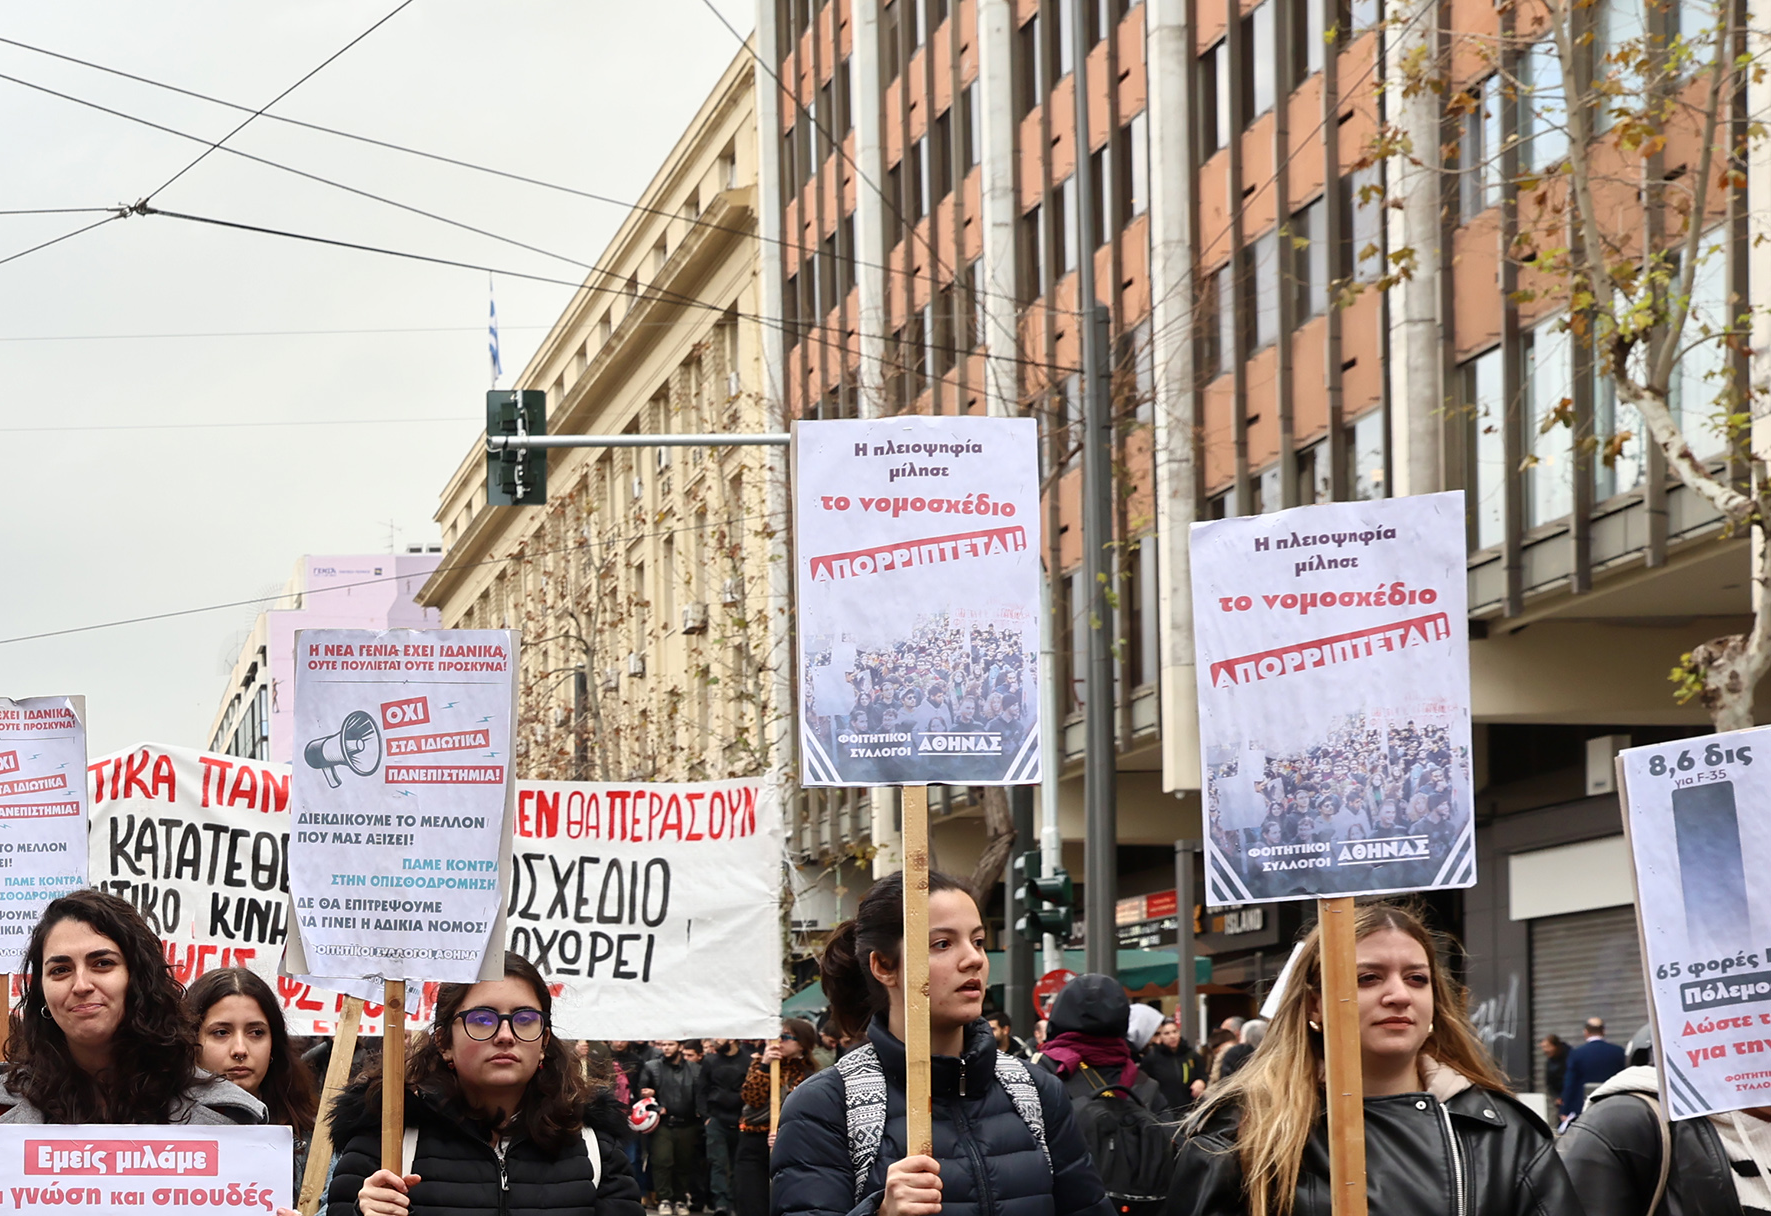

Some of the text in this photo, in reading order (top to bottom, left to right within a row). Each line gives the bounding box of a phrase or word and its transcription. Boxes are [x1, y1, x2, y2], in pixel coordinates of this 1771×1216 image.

[855, 439, 982, 457] Η πλειοψηφία
[889, 463, 949, 482] μίλησε
[821, 493, 1016, 518] το νομοσχέδιο
[1255, 525, 1396, 551] Η πλειοψηφία
[813, 531, 1025, 581] ΑΠΟΡΡΙΠΤΕΤΑΙ!
[1295, 555, 1358, 576] μίλησε
[1219, 582, 1437, 615] το νομοσχέδιο
[310, 644, 507, 660] Η ΝΕΑ ΓΕΝΙΑ ΕΧΕΙ ΙΔΑΝΙΚΑ,
[1214, 618, 1448, 688] ΑΠΟΡΡΙΠΤΕΤΑΙ!
[386, 702, 424, 724] ΟΧΙ
[390, 733, 486, 752] ΣΤΑ ΙΔΙΩΤΙΚΑ
[838, 732, 911, 744] ΦΟΙΤΗΤΙΚΟΙ
[919, 736, 1002, 751] ΑΘΗΝΑΣ
[850, 747, 911, 758] ΣΥΛΛΟΓΟΙ
[1649, 743, 1753, 779] 8,6 δις
[199, 757, 292, 814] ΠΑΝ
[388, 769, 499, 781] ΠΑΝΕΠΙΣΤΗΜΙΑ!
[1675, 769, 1727, 789] για F-35
[514, 786, 758, 842] ΕΝ ΘΑ ΠΕΡΑΣΟΥΝ
[1248, 842, 1330, 857] ΦΟΙΤΗΤΙΚΟΙ
[1338, 839, 1430, 862] ΑΘΗΝΑΣ
[1263, 857, 1331, 872] ΣΥΛΛΟΓΟΙ
[210, 892, 289, 945] ΚΙΝΗ
[1656, 951, 1759, 980] 65 φορές
[1684, 982, 1771, 1004] Πόλεμο
[1682, 1016, 1753, 1037] Δώστε
[1686, 1044, 1726, 1068] για
[37, 1144, 207, 1174] Εμείς μιλάμε
[11, 1181, 101, 1209] γνώση
[111, 1190, 145, 1206] και
[152, 1182, 274, 1211] σπουδές
